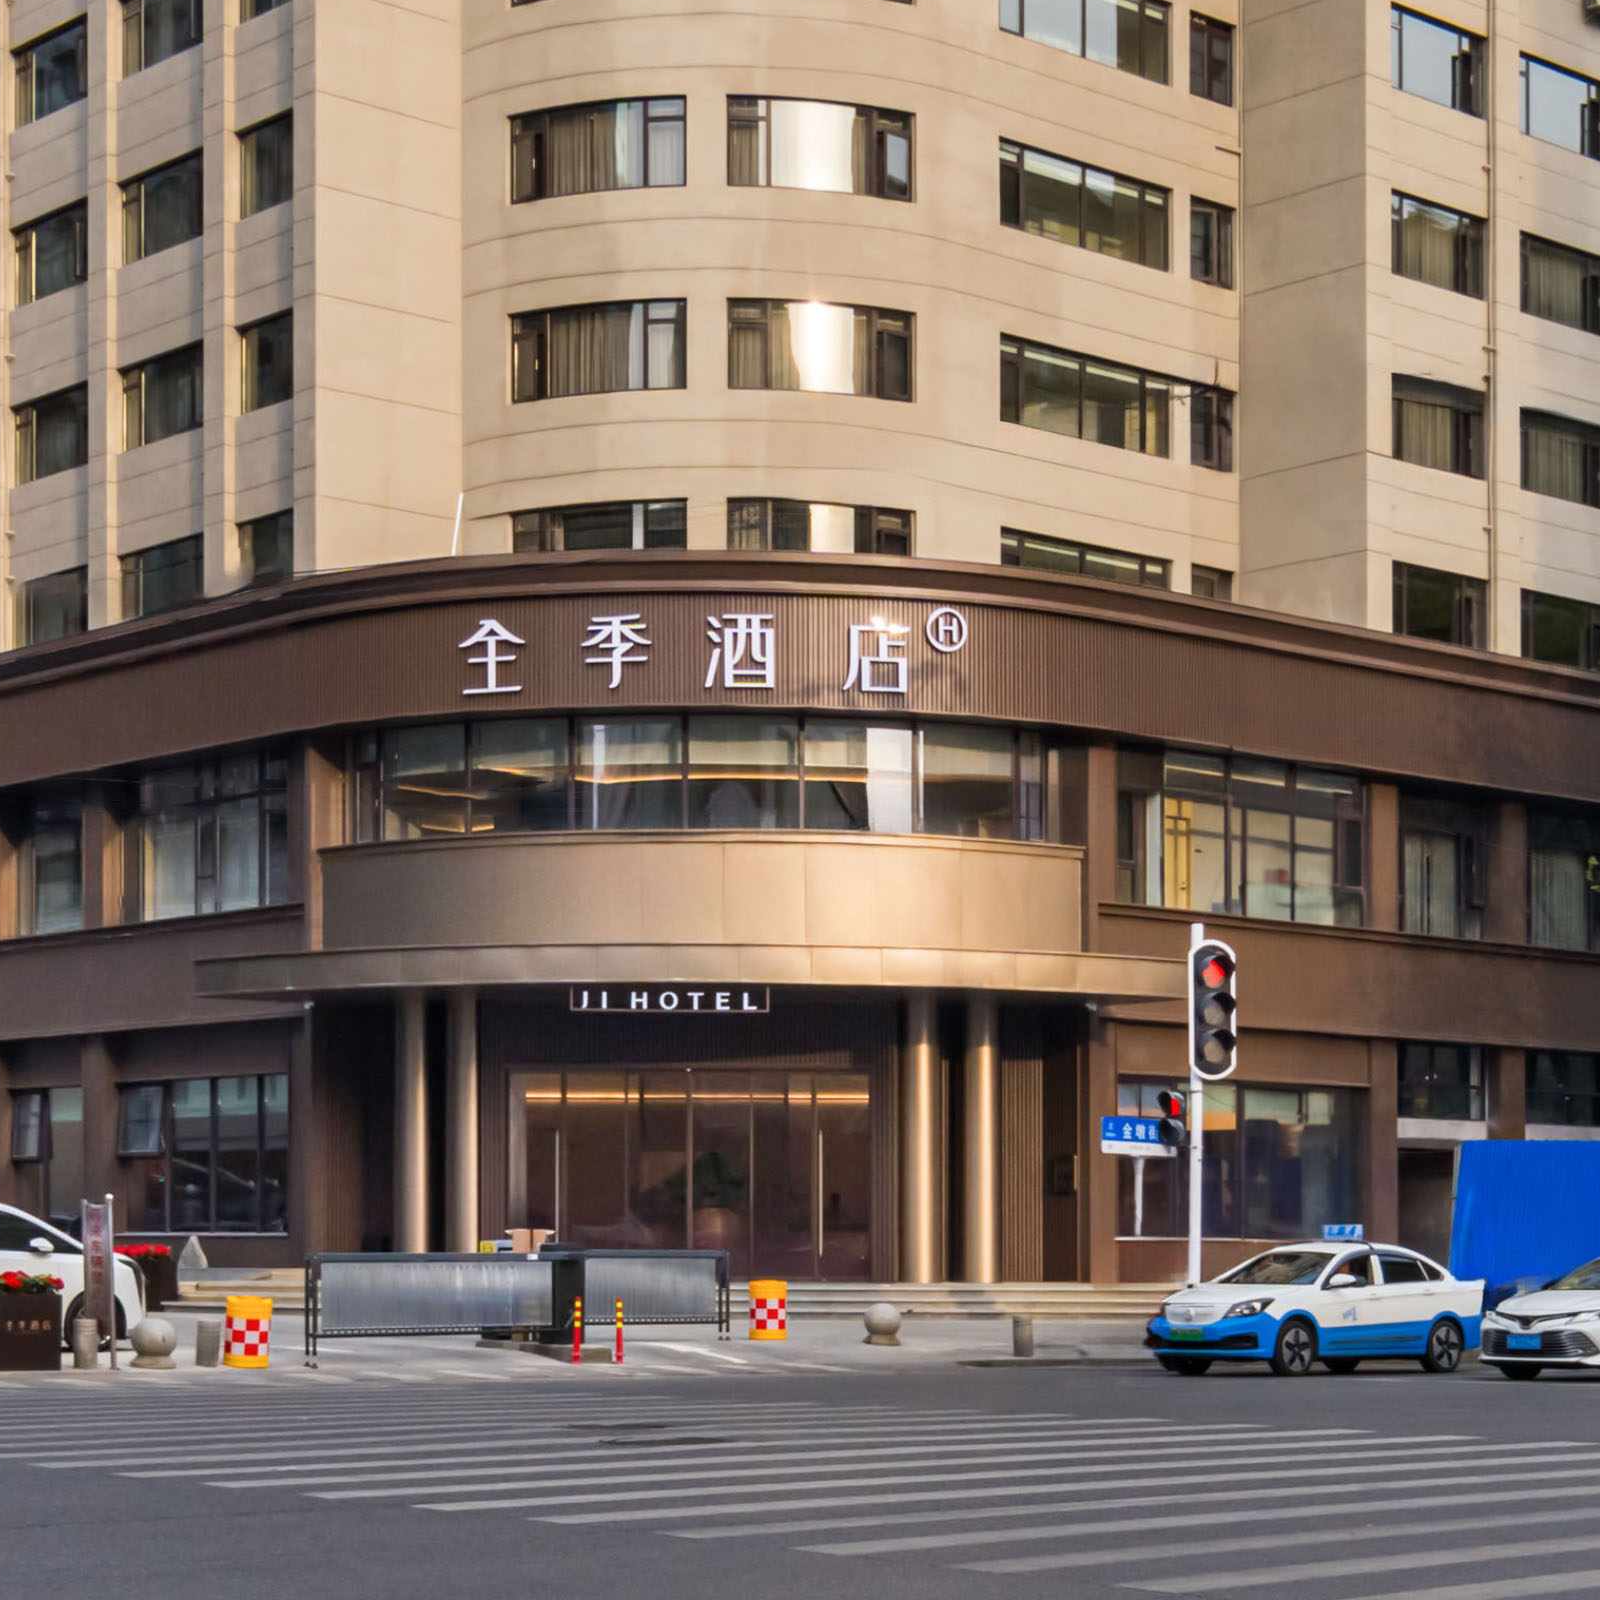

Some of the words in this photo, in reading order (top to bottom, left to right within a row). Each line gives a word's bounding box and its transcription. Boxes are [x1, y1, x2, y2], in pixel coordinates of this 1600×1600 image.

[458, 611, 910, 695] 全季酒店
[580, 990, 608, 1009] JI
[630, 991, 758, 1010] HOTEL
